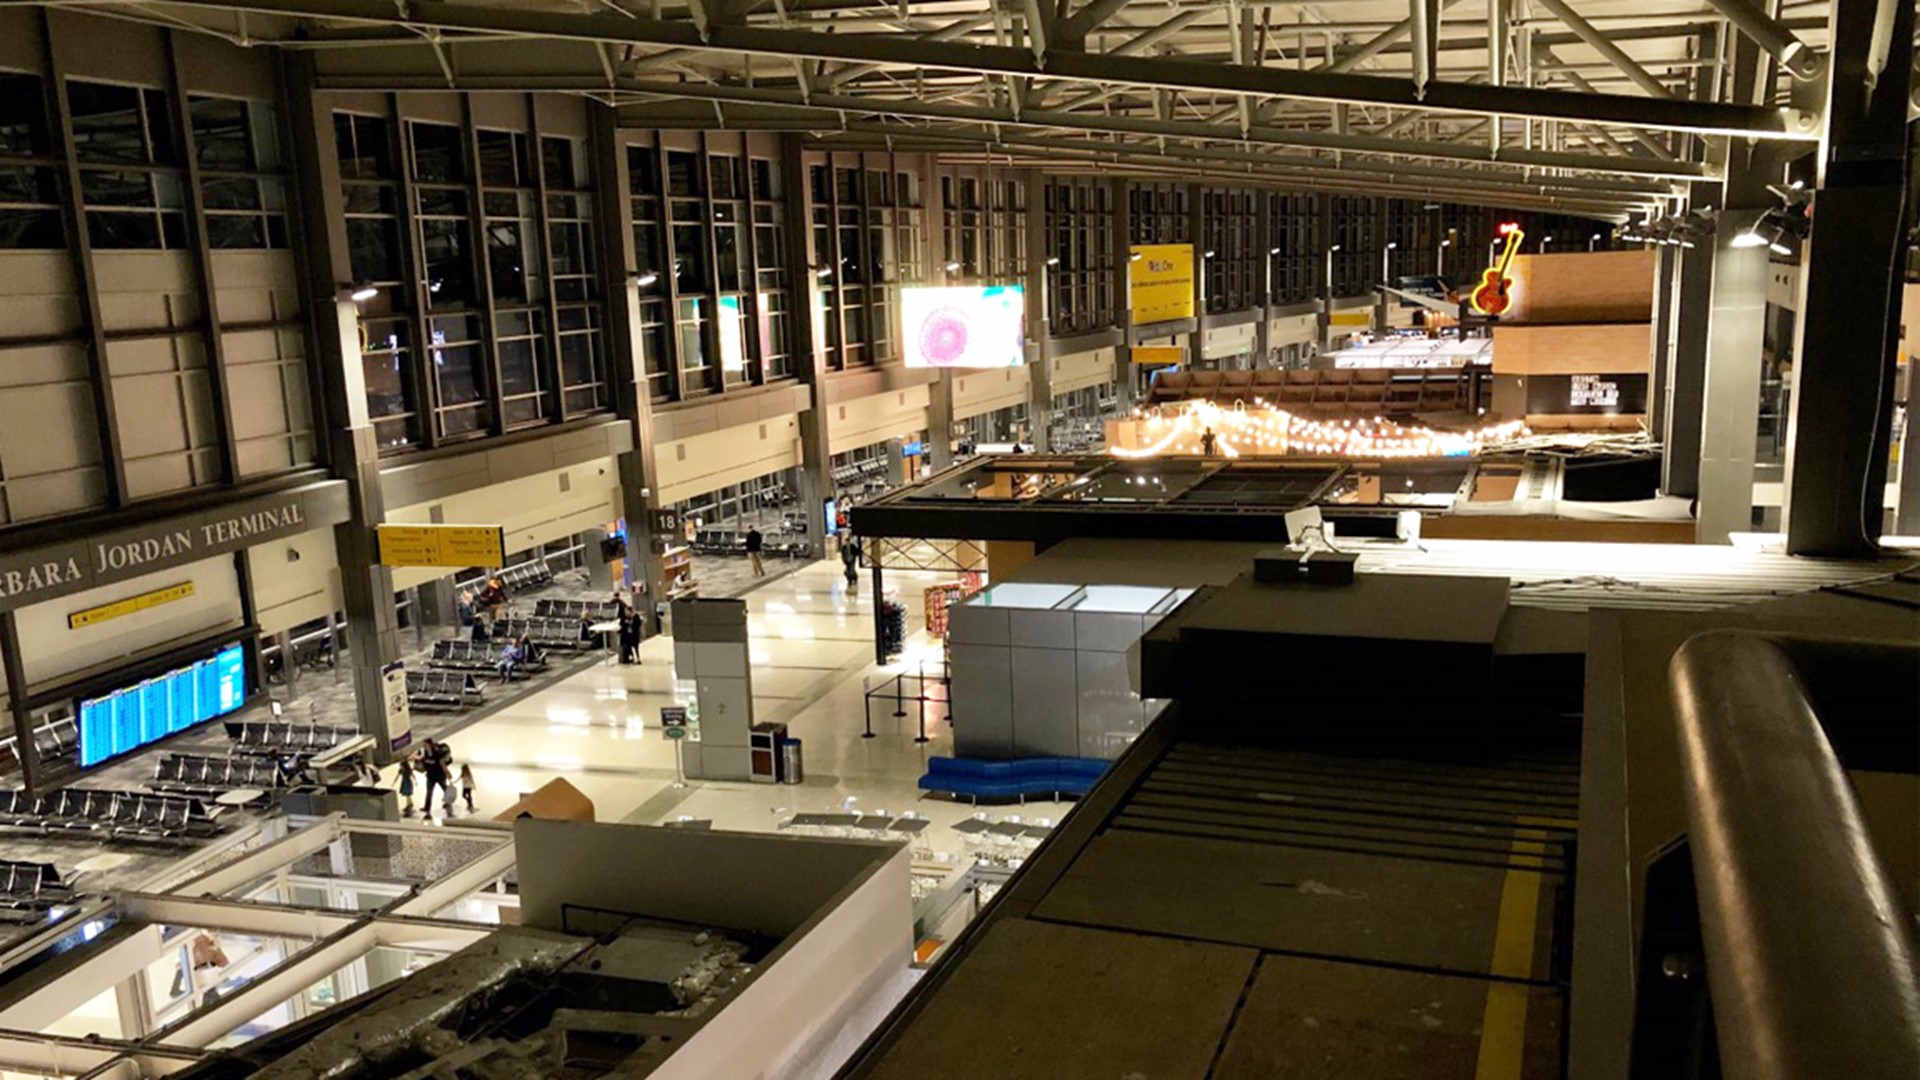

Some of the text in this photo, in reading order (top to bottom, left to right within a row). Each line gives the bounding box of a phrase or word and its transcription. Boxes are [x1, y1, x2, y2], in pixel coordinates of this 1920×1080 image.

[97, 529, 193, 574] JORDAN
[201, 504, 303, 546] TERMINAL
[659, 515, 675, 529] 18
